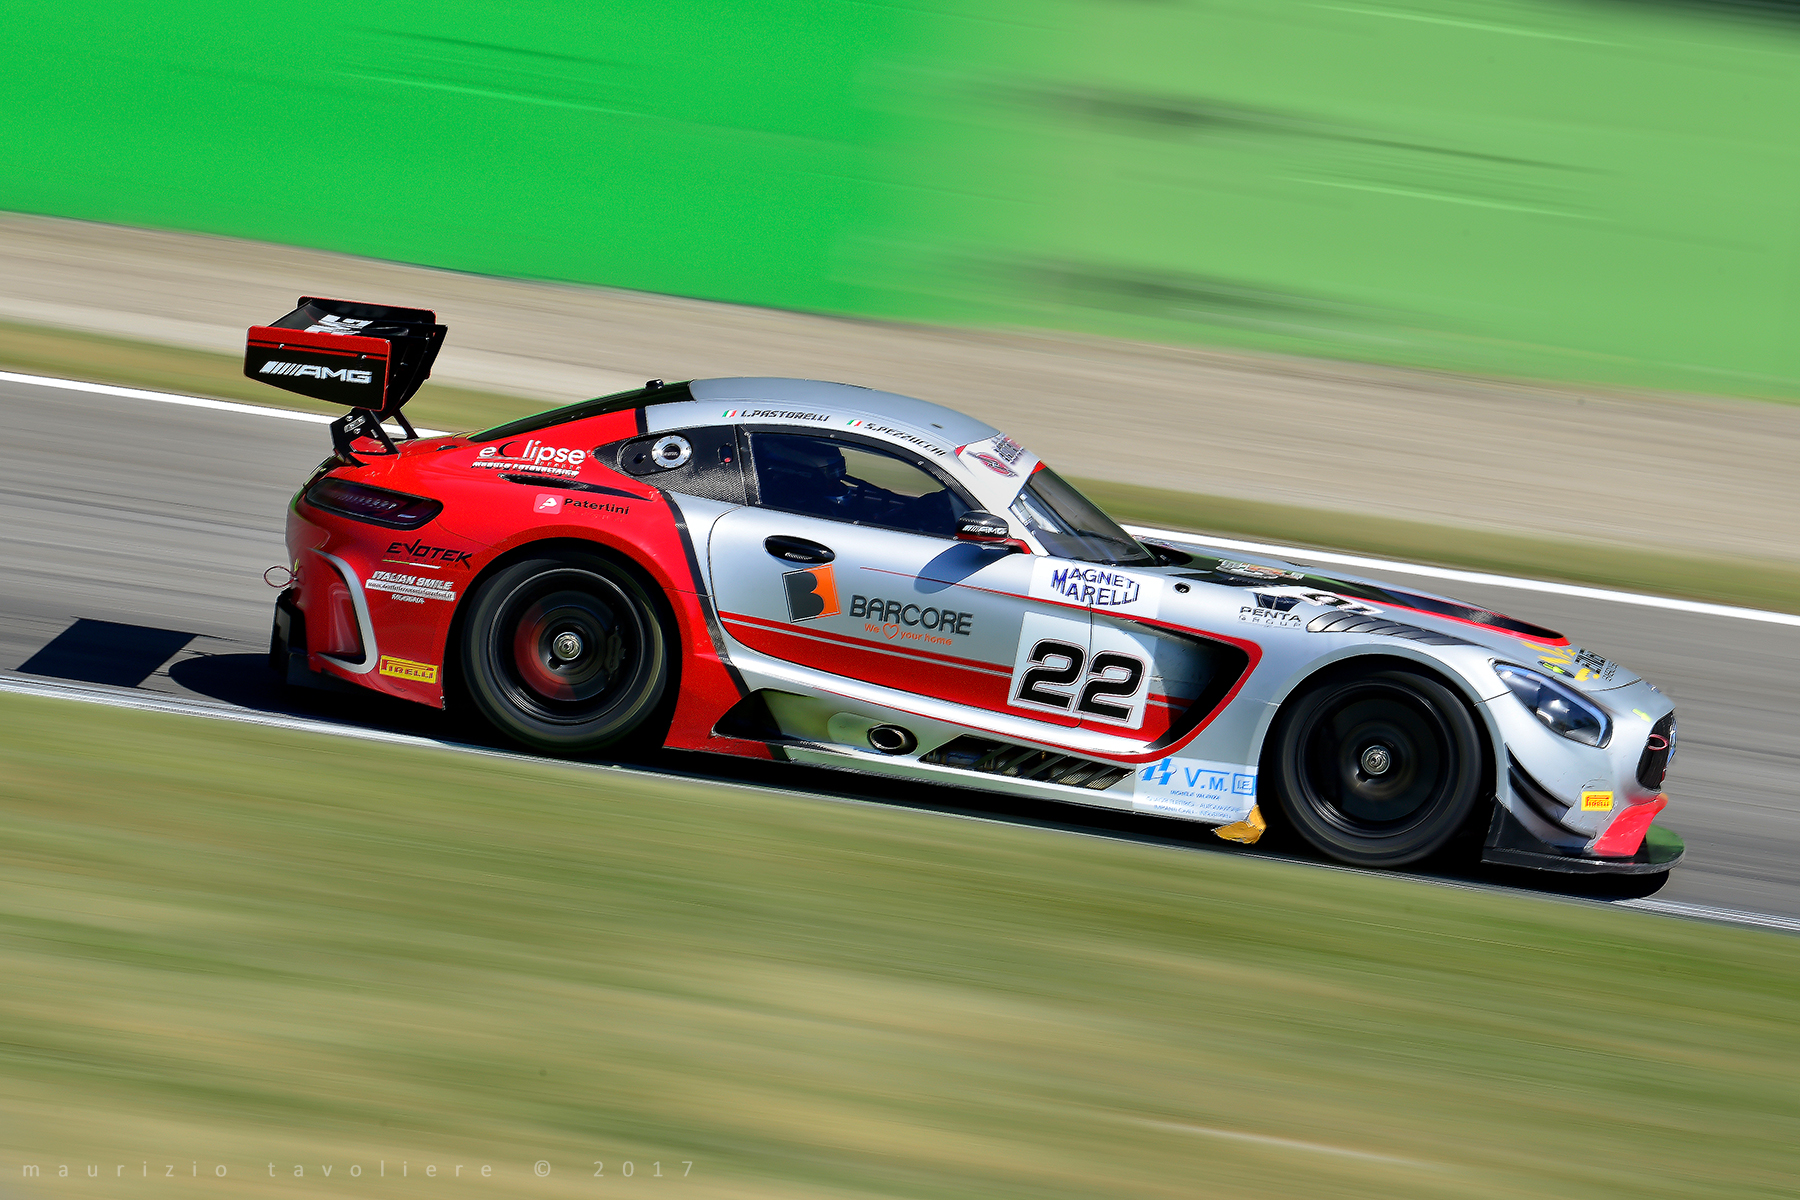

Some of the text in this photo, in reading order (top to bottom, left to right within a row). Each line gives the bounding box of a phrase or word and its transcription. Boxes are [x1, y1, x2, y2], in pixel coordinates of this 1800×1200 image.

[740, 410, 830, 422] L.PASTORELLI
[863, 422, 947, 457] S.PEZZUCCHI
[563, 498, 630, 515] Paterlini
[386, 538, 473, 571] EVOTEK
[371, 570, 417, 585] ITALIAN
[415, 577, 454, 591] SMILE
[849, 594, 974, 636] BARCORE
[1239, 606, 1302, 623] PENTA
[864, 622, 953, 646] We your home
[381, 658, 435, 680] PIRELLI
[1013, 637, 1146, 723] 22
